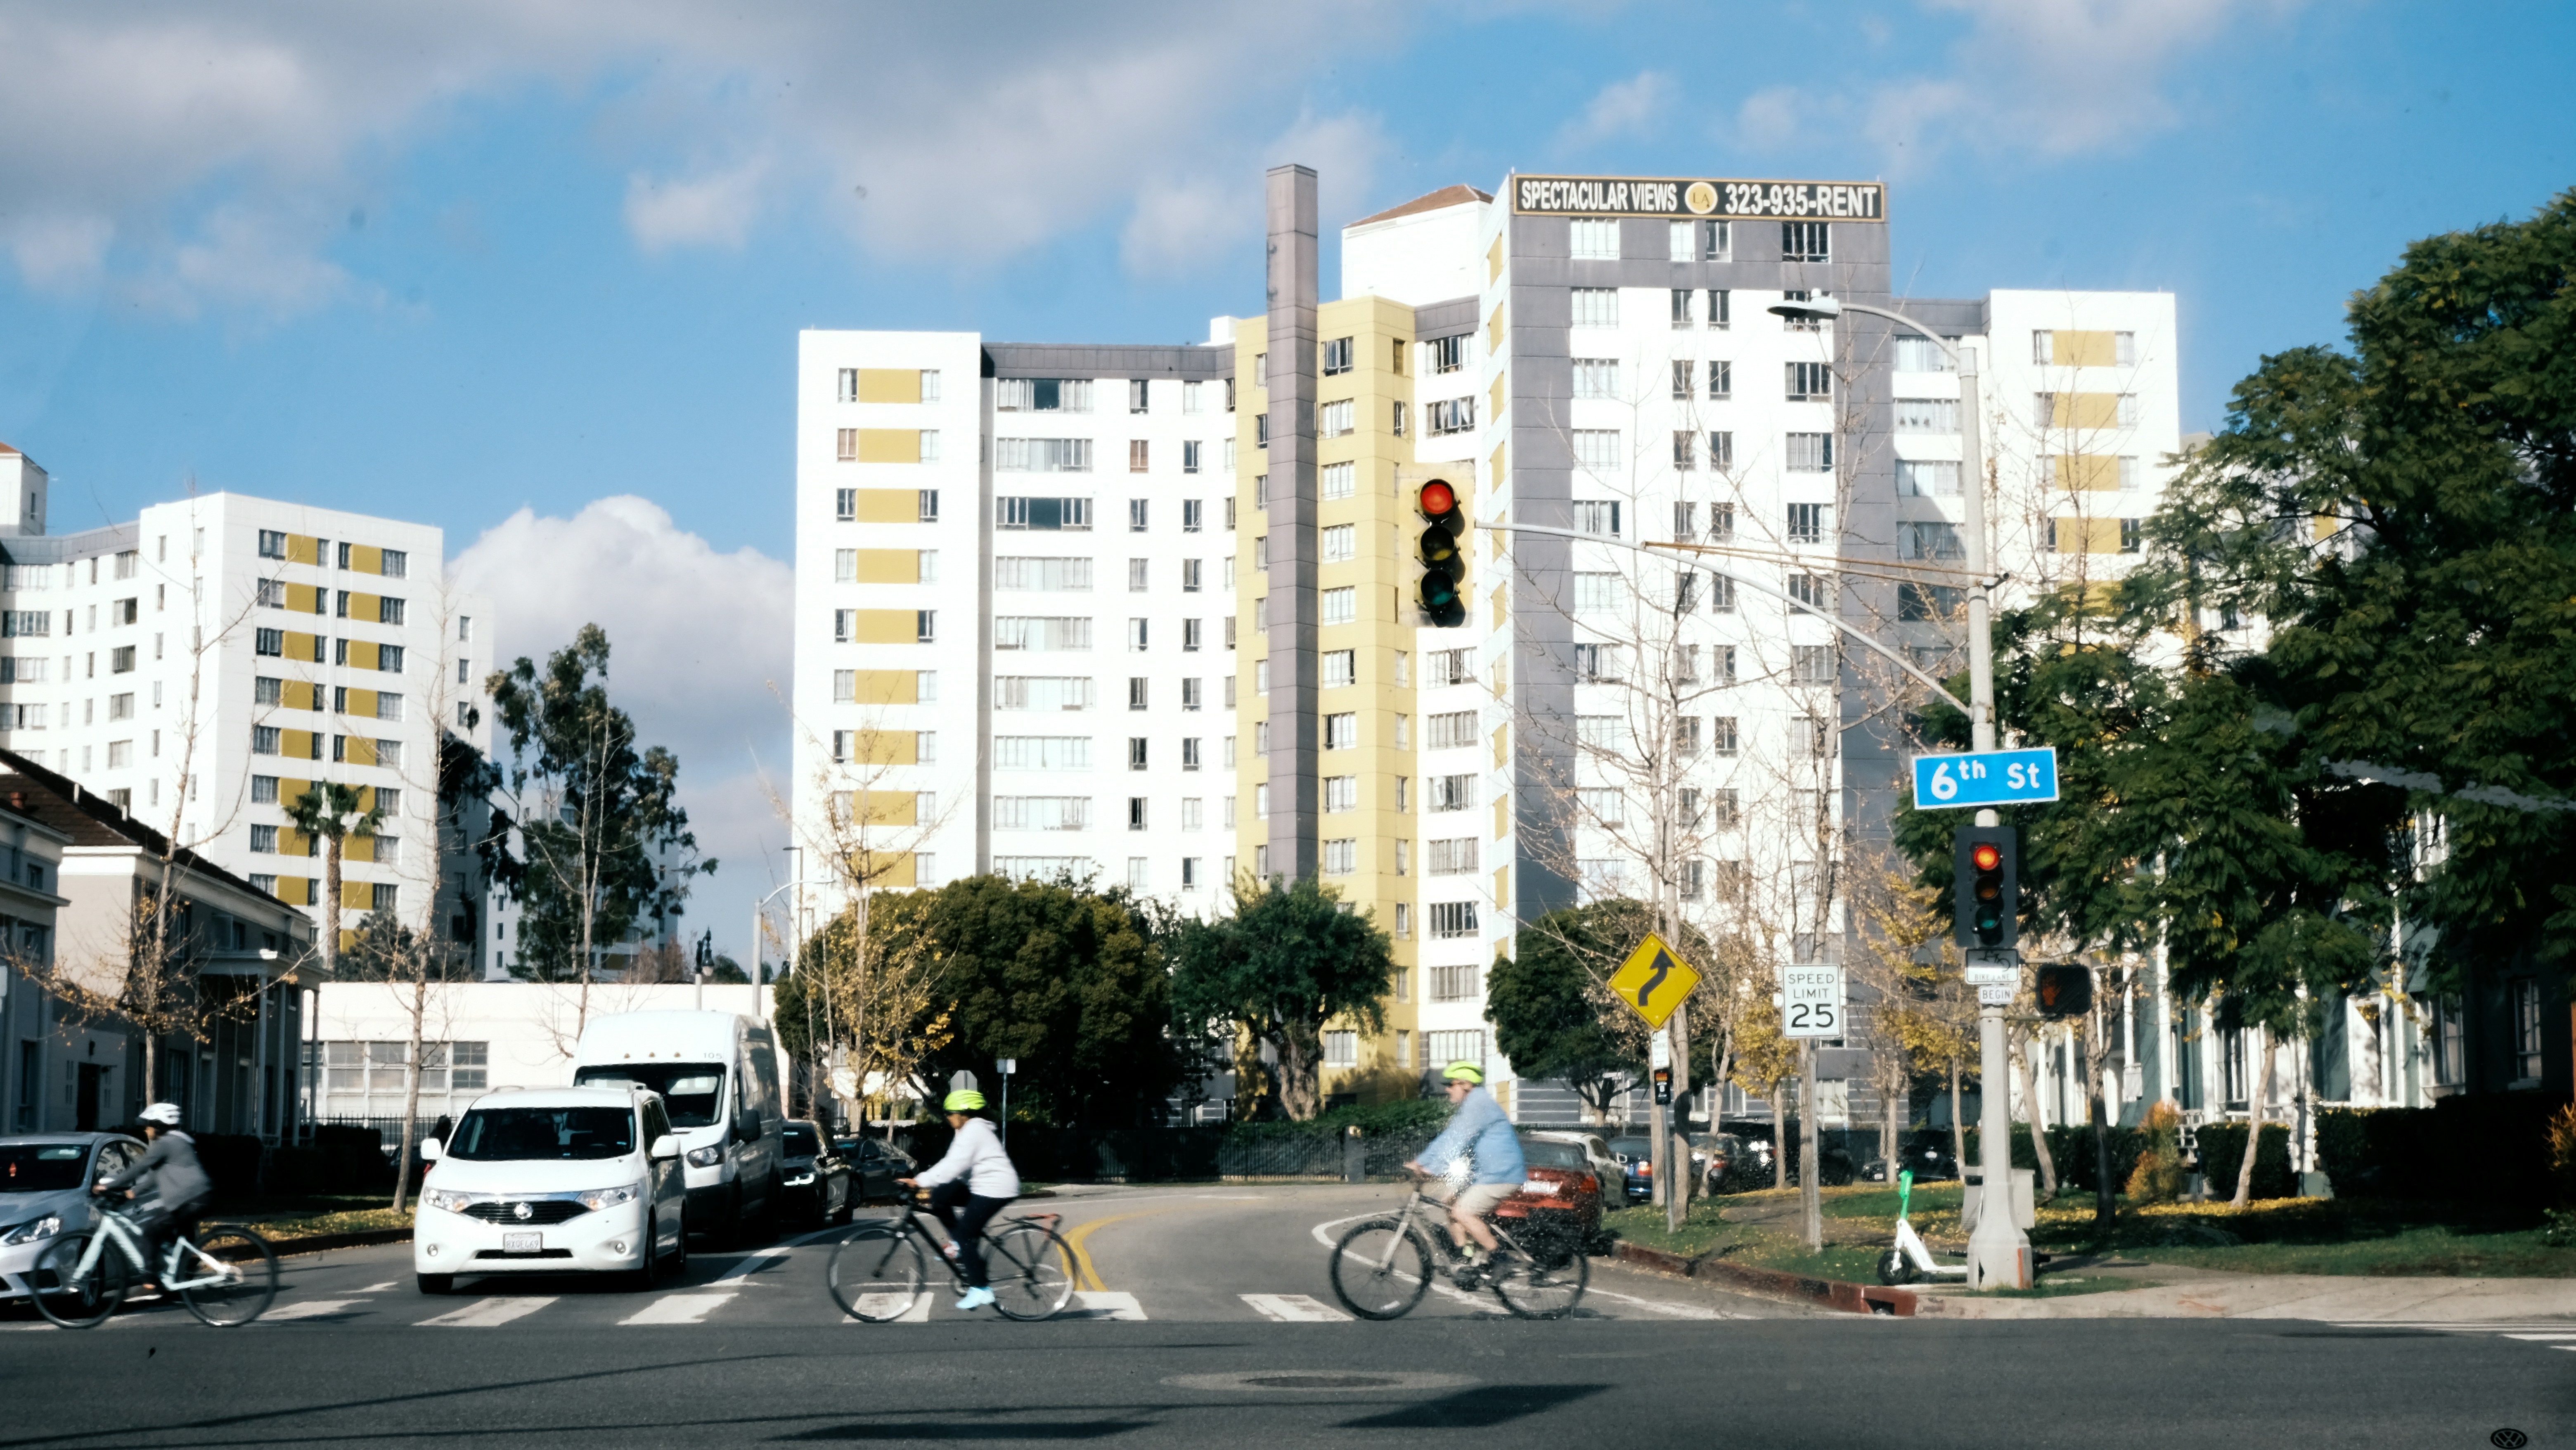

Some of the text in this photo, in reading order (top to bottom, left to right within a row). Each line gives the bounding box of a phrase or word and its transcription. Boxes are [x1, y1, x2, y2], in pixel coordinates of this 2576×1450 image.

[1521, 180, 1678, 211] SPECTACULAR VIEWS
[1725, 183, 1878, 217] 323-935-RENT
[1931, 759, 2040, 800] 6th St
[1788, 974, 1834, 984] SPEED
[1794, 988, 1829, 998] LIMIT
[1983, 990, 2010, 999] BEGIN
[1791, 1003, 1834, 1028] 25
